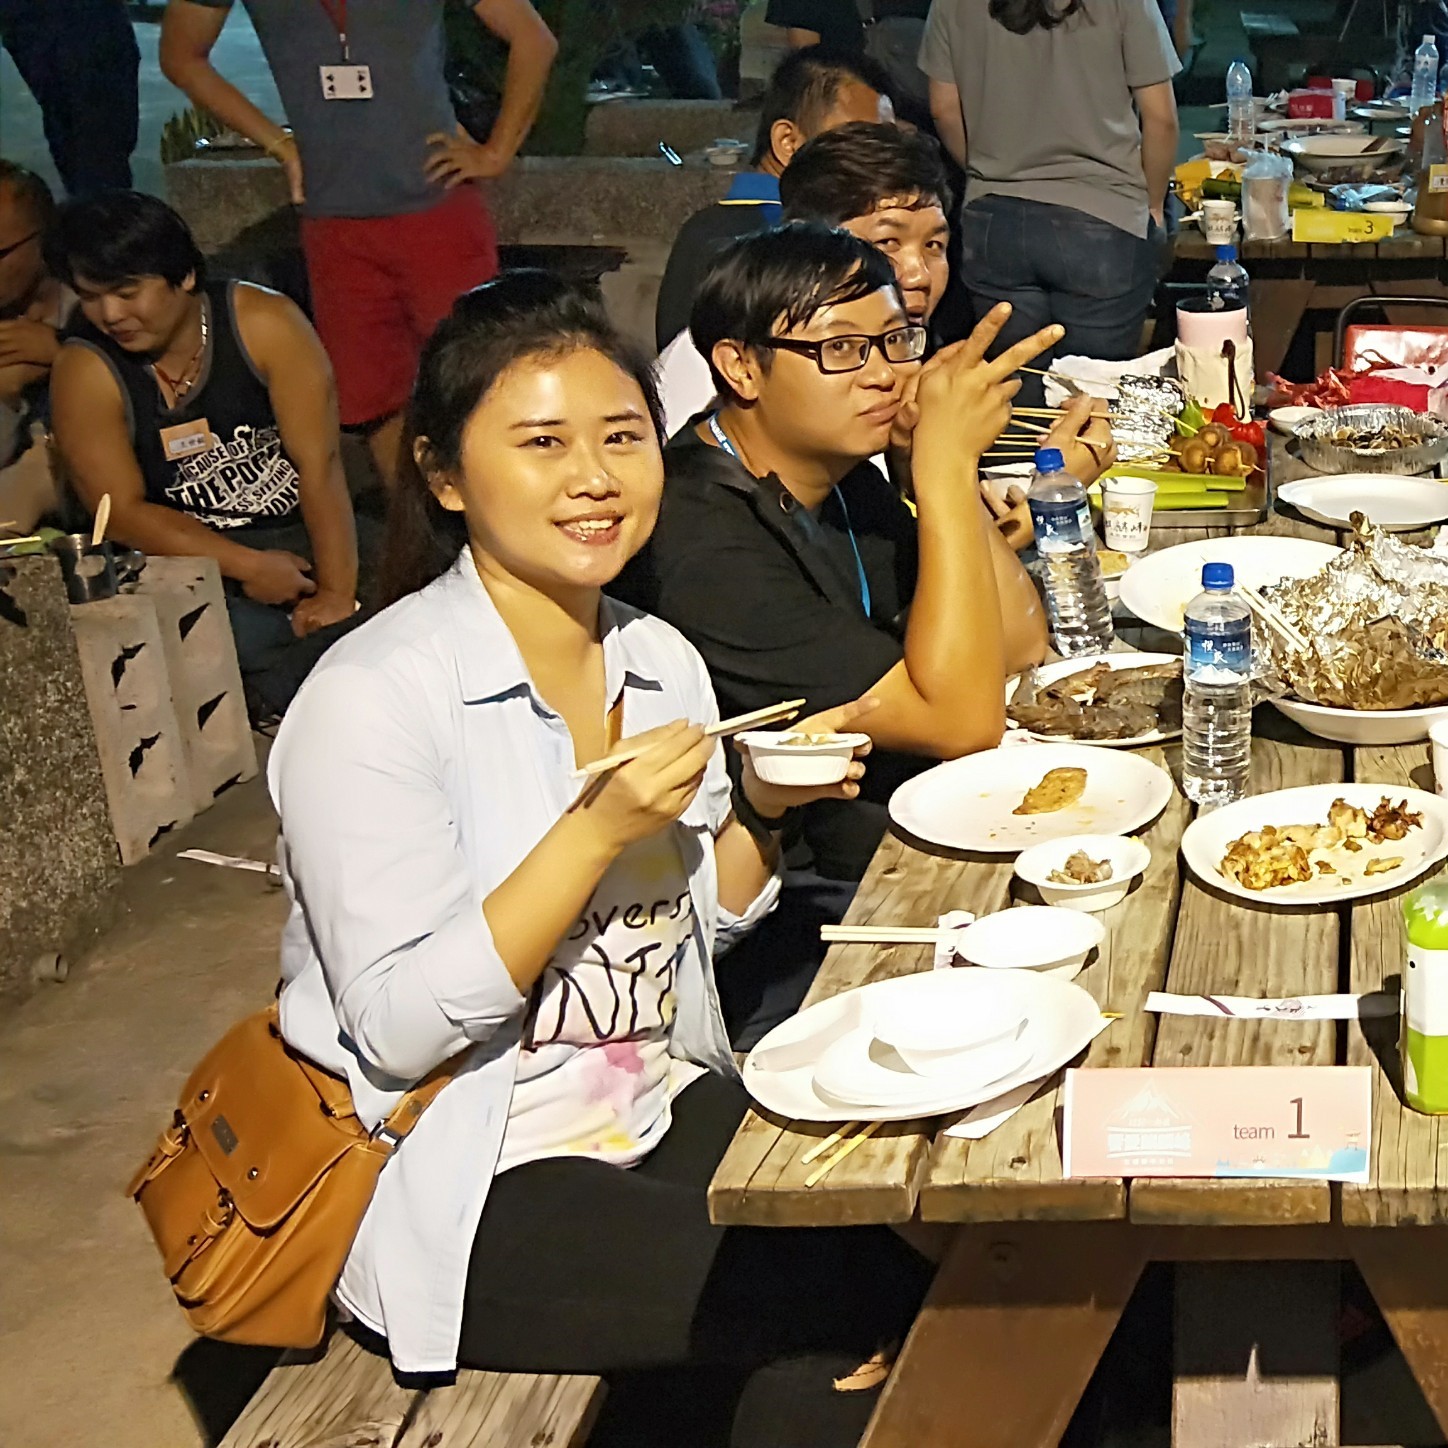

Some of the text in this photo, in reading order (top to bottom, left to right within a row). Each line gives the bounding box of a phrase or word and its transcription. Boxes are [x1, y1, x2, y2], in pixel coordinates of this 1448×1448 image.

[1364, 220, 1374, 235] 3
[252, 461, 291, 501] SITTING
[1233, 1098, 1310, 1140] team 1
